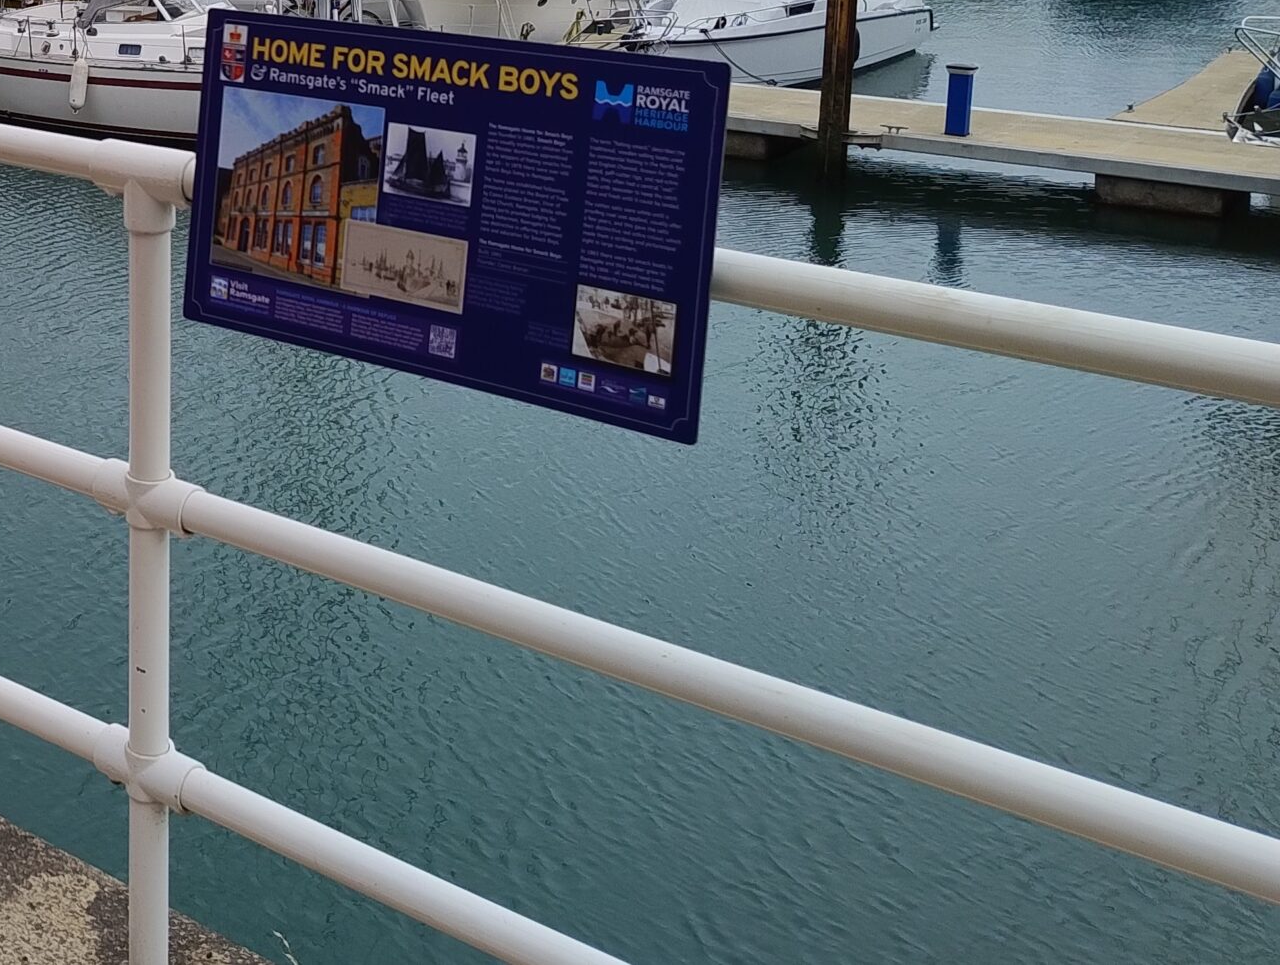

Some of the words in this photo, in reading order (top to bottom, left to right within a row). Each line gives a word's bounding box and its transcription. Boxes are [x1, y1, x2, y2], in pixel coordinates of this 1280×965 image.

[252, 37, 325, 69] HOME
[332, 46, 385, 76] FOR
[391, 53, 490, 90] SMACK
[498, 65, 580, 101] BOYS
[250, 64, 268, 81] &
[269, 68, 347, 90] Ramsgate's
[417, 87, 456, 106] Fleet
[637, 85, 690, 100] RAMSGATE
[635, 95, 690, 114] ROYAL
[634, 108, 689, 123] HERITAGE
[633, 117, 689, 132] HARBOUR
[230, 280, 249, 292] Visit
[229, 287, 271, 305] Ramsgate
